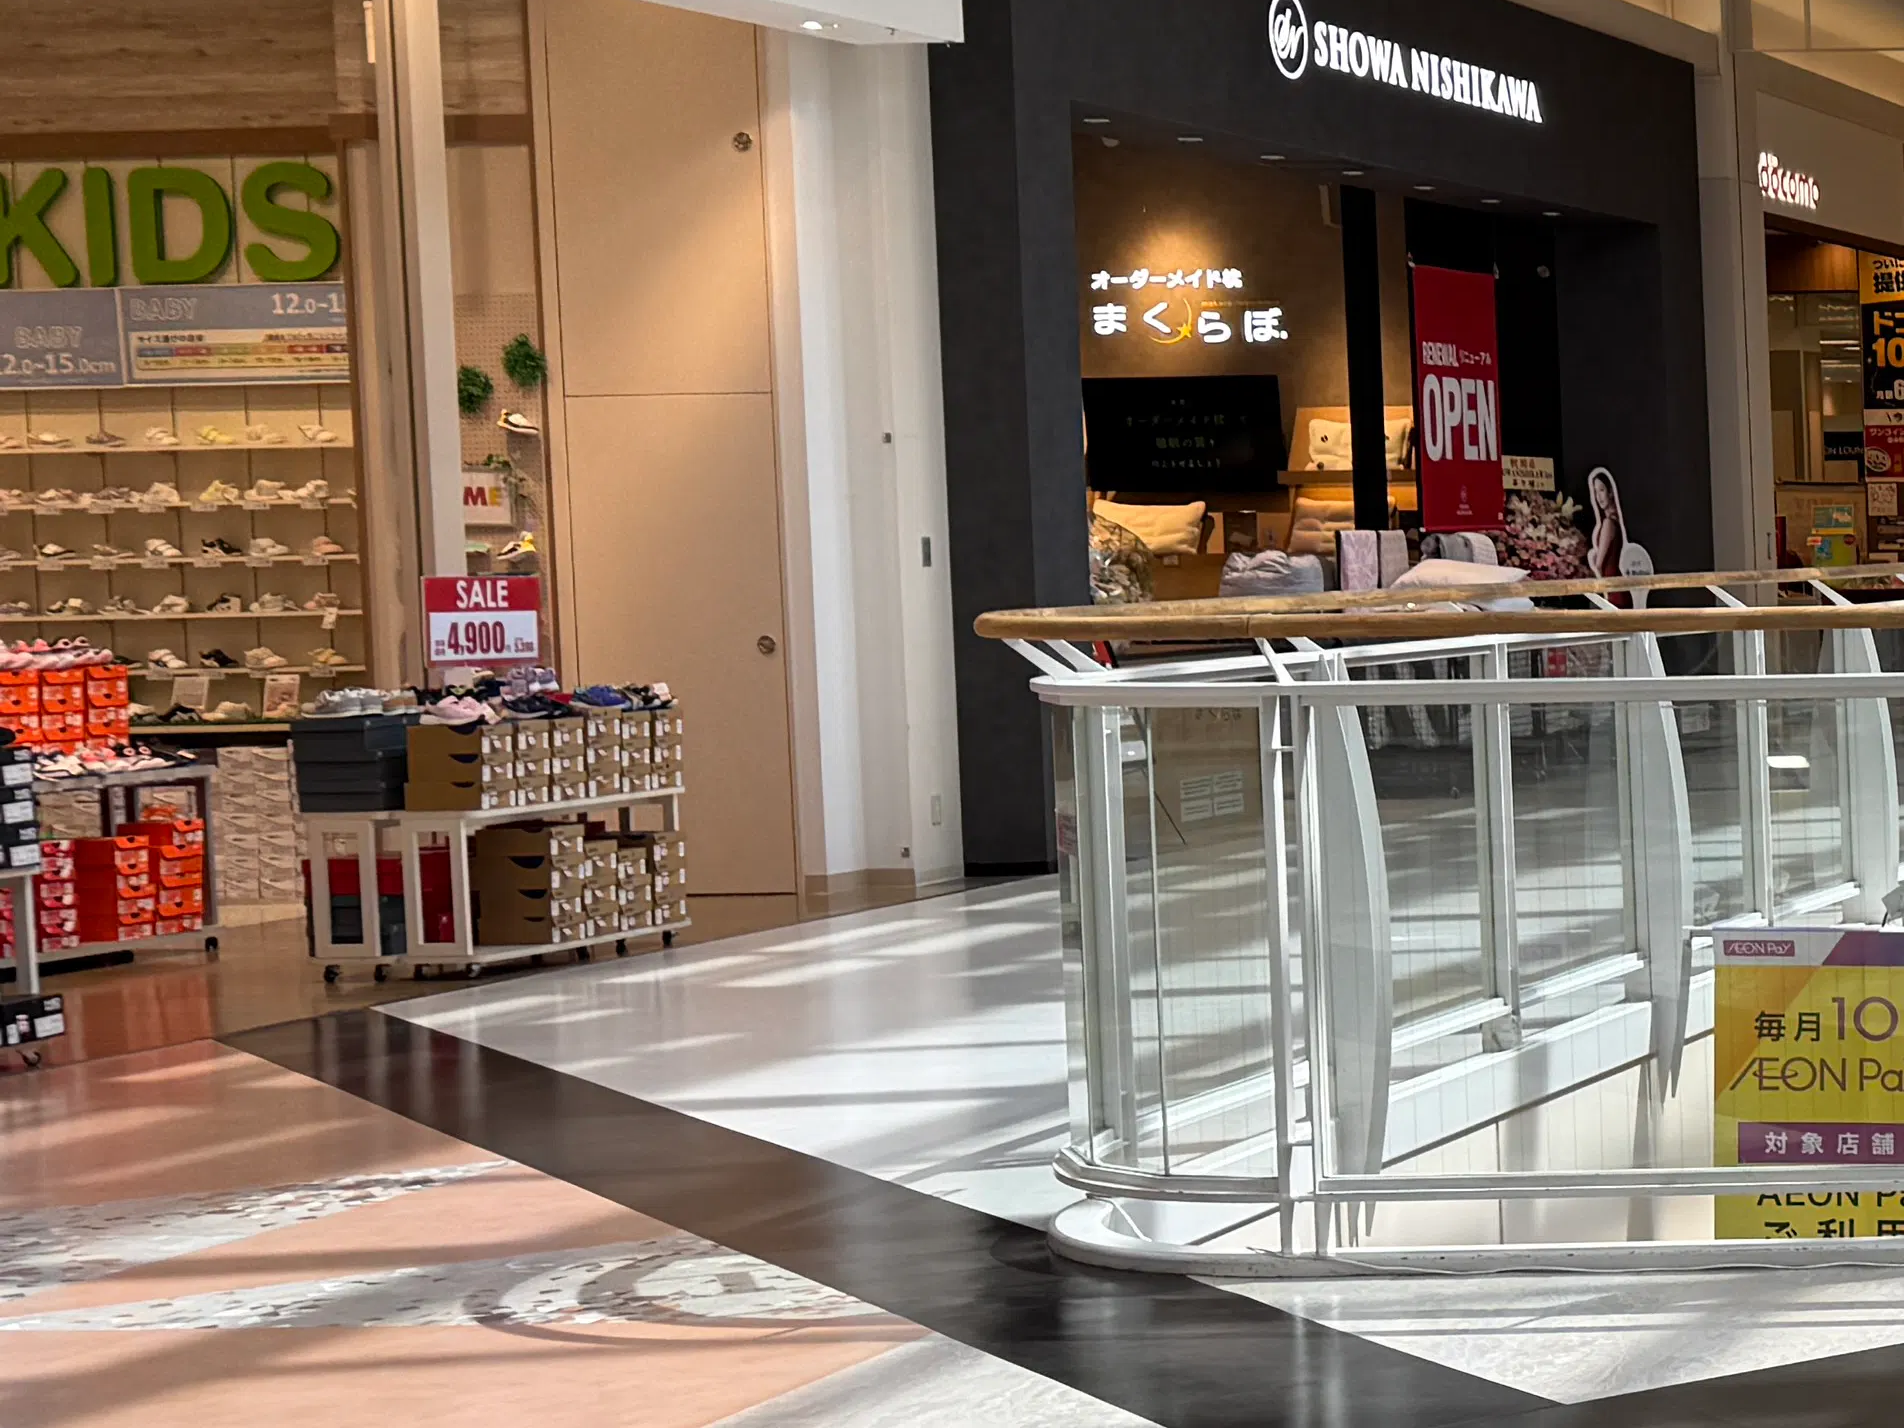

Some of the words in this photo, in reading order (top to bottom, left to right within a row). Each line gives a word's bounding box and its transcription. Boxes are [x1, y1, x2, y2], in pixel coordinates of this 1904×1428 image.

[1313, 20, 1408, 89] SHOWA
[1410, 47, 1543, 123] NISHIKAWA
[0, 160, 341, 290] KIDS
[129, 297, 198, 321] BABY
[13, 325, 83, 349] BABY
[1422, 373, 1498, 462] OPEN
[456, 580, 509, 608] SALE
[447, 620, 505, 656] 4,900
[1756, 1190, 1860, 1208] AEON
